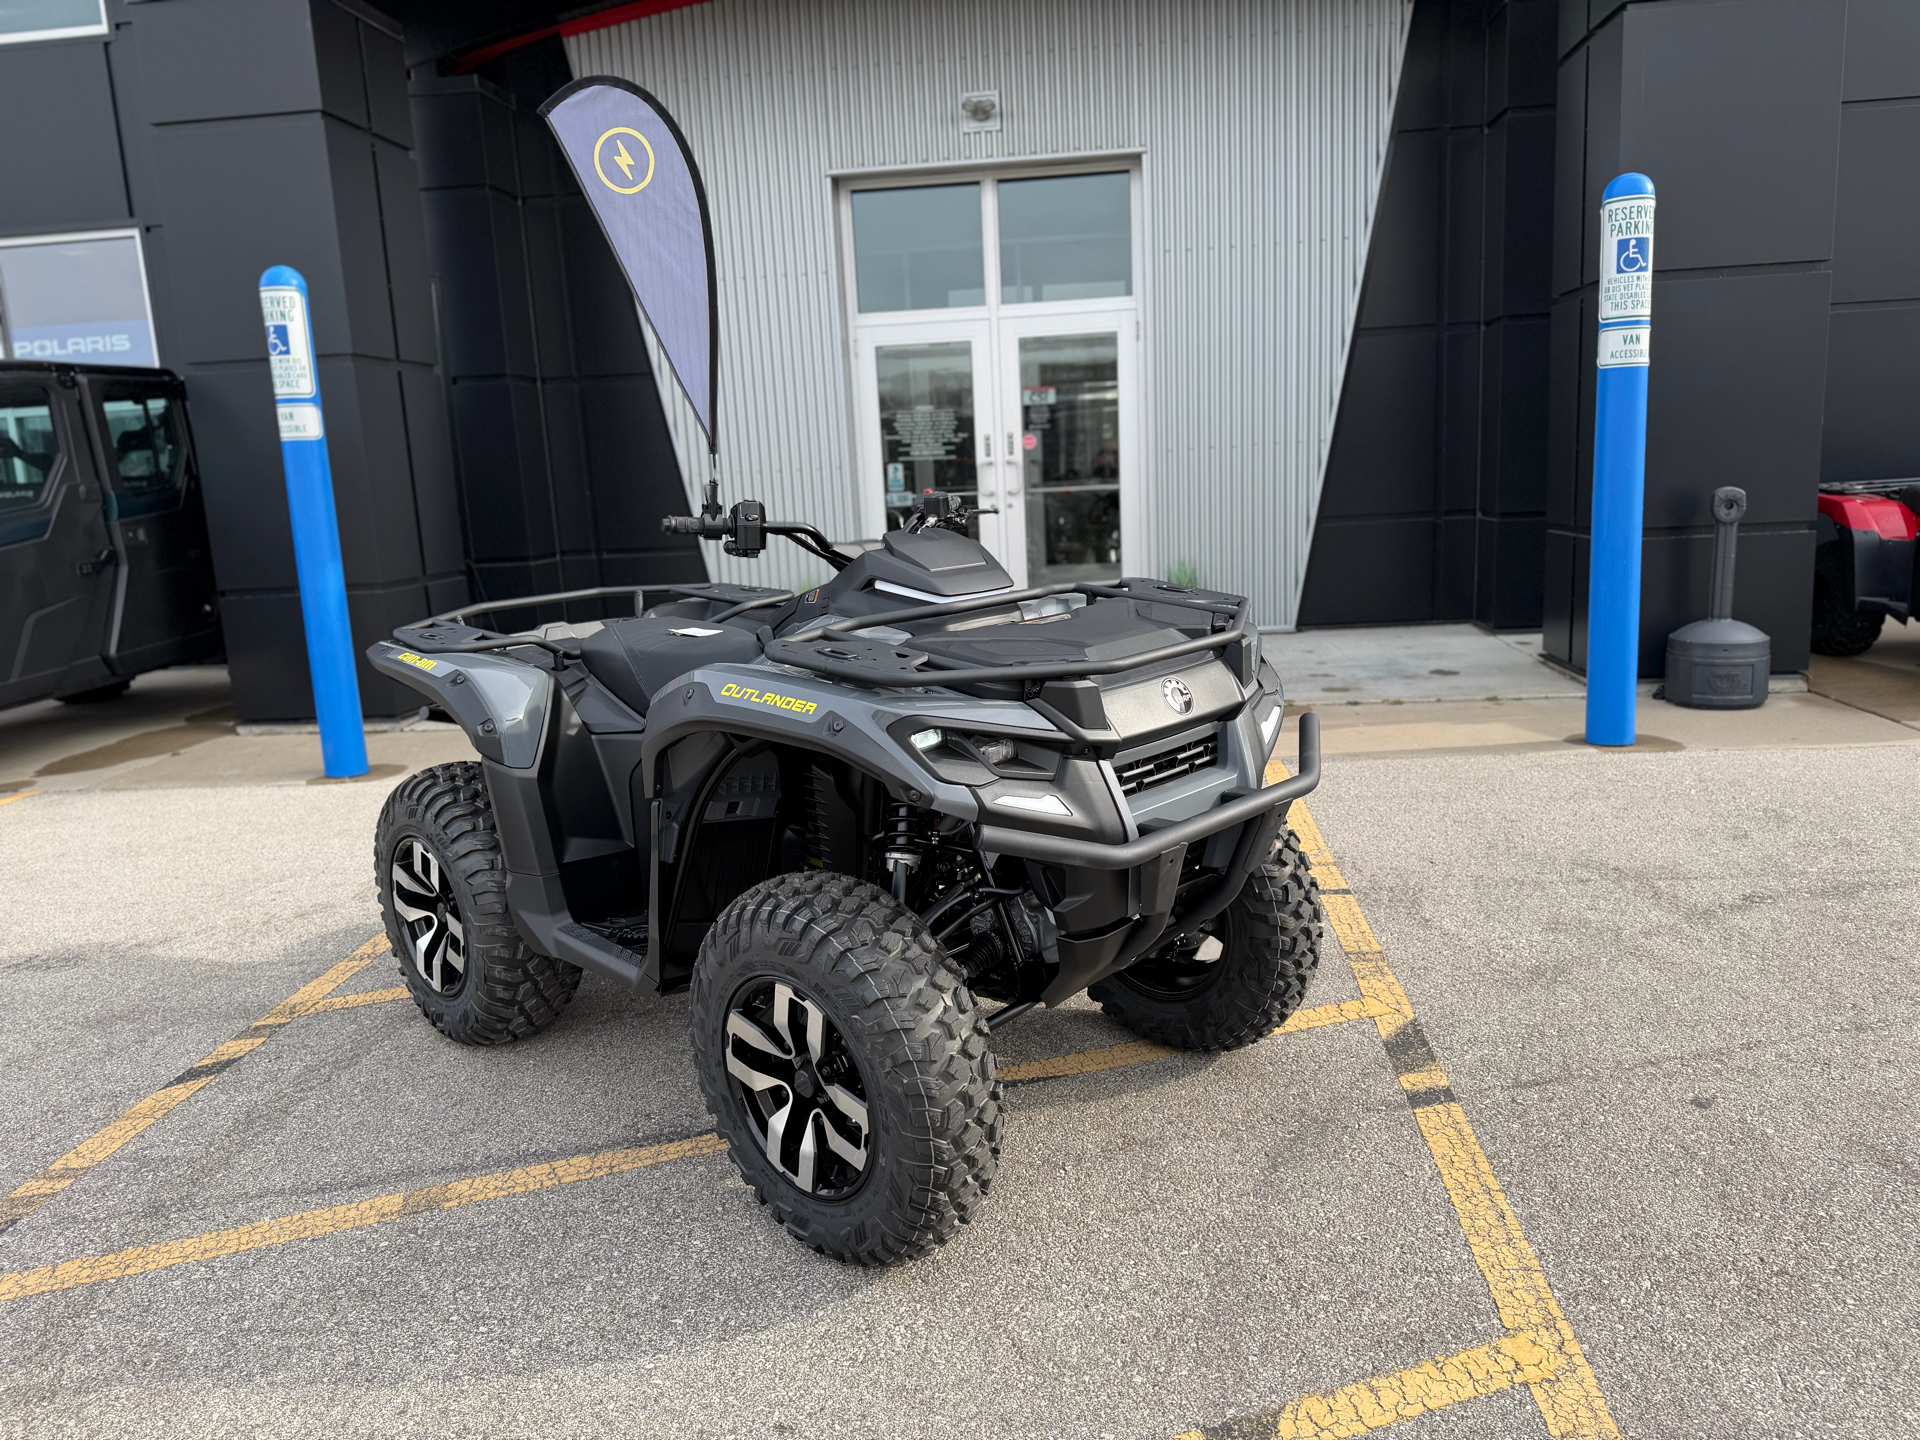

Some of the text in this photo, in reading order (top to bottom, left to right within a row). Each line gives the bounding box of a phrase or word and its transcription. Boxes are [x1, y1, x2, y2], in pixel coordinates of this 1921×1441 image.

[1607, 275, 1635, 285] VEHICLES
[1612, 284, 1622, 293] DIS
[1610, 301, 1628, 311] THIS
[1622, 333, 1641, 345] VAN
[13, 334, 131, 358] POLARIS
[720, 683, 818, 715] OUTLANDER
